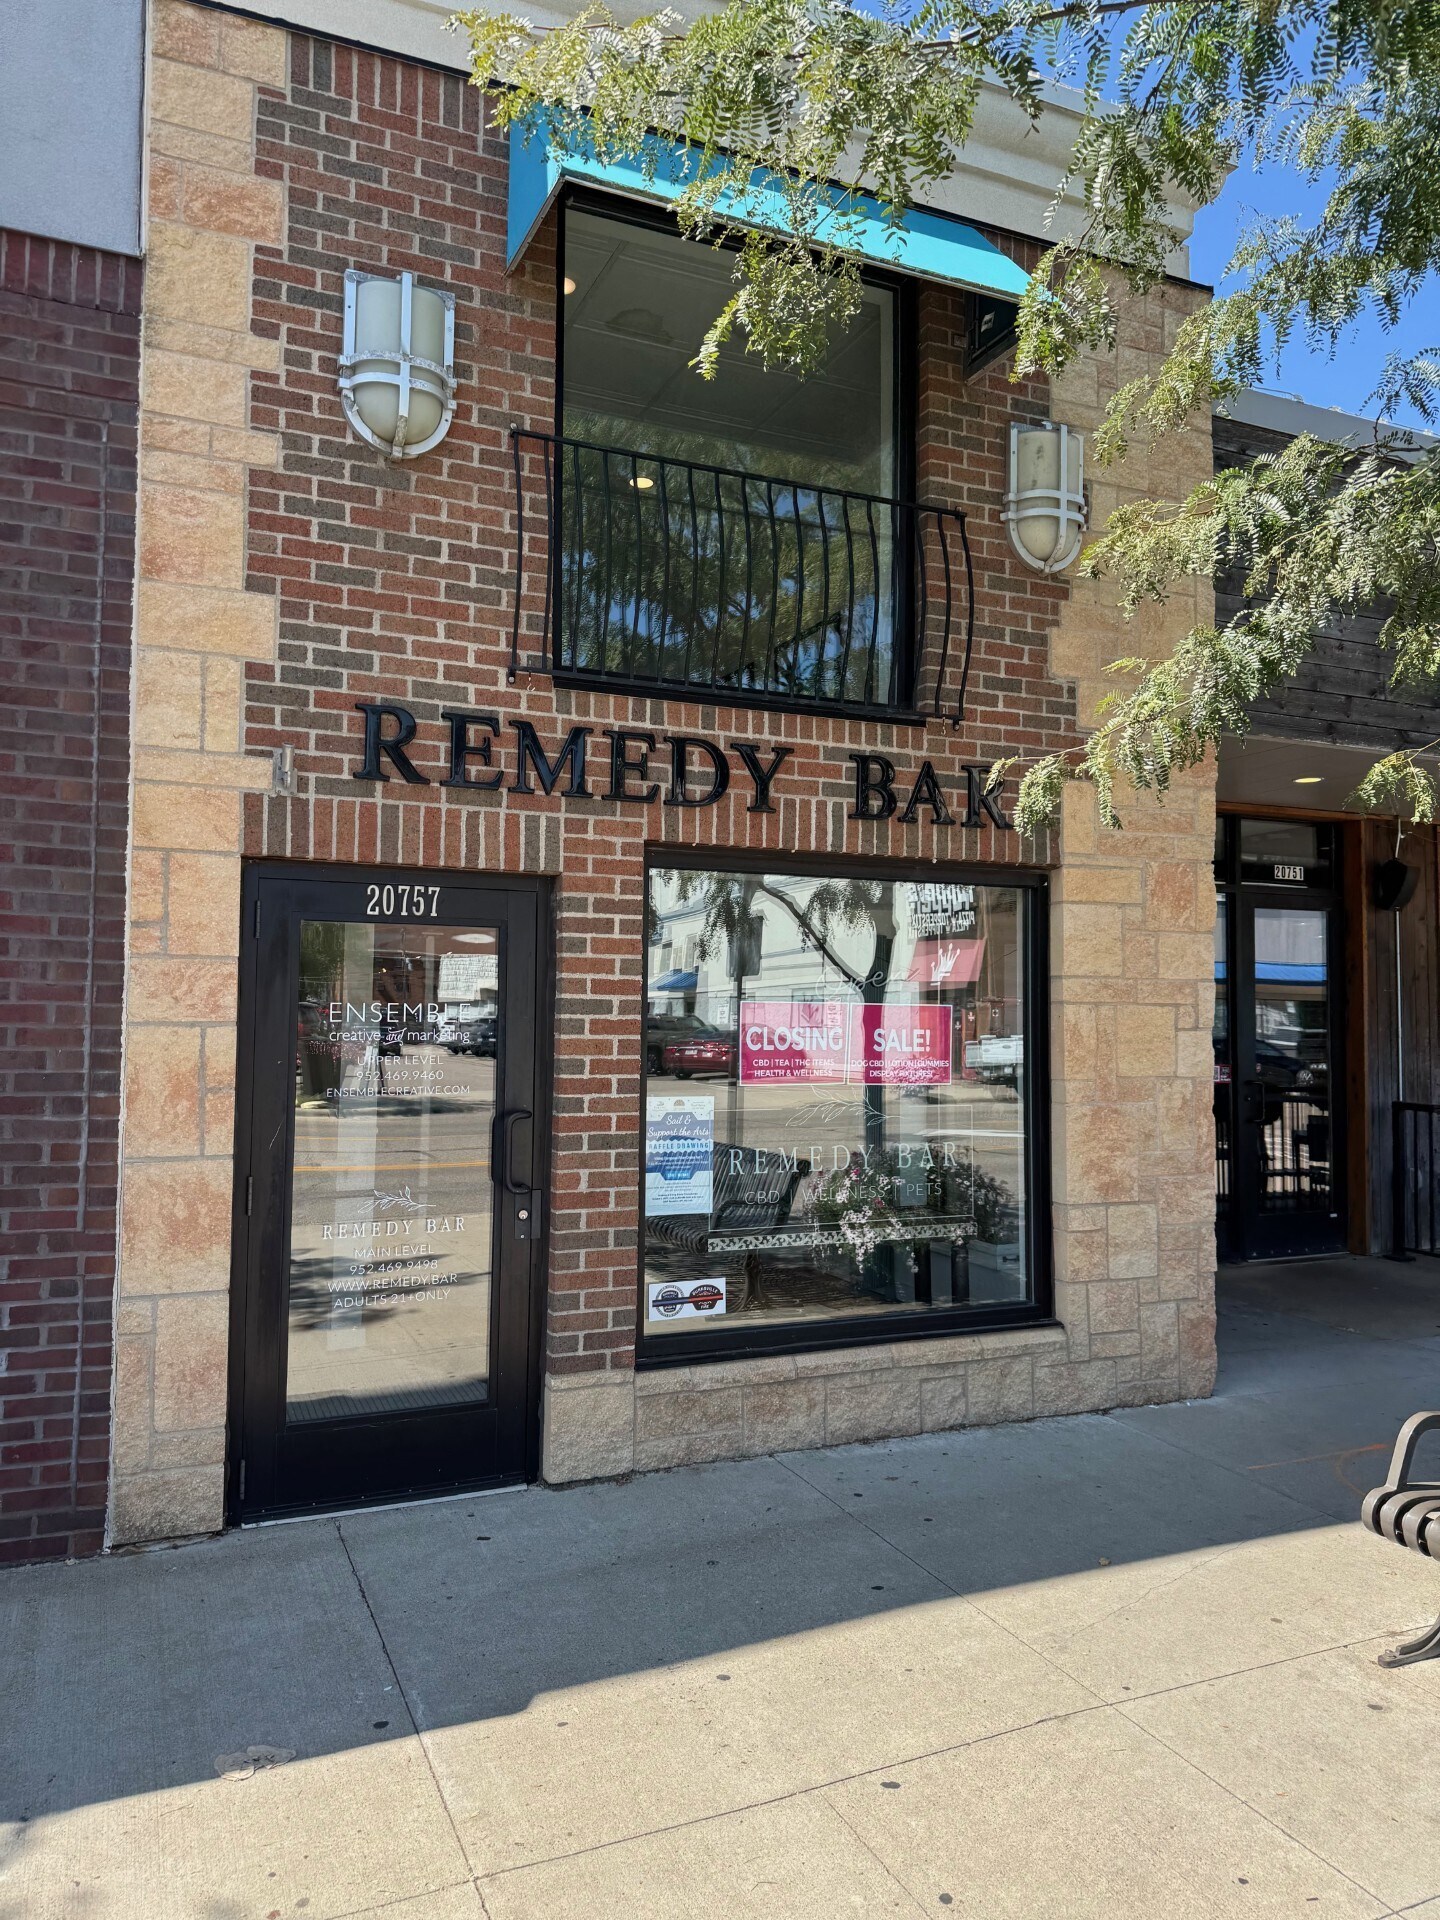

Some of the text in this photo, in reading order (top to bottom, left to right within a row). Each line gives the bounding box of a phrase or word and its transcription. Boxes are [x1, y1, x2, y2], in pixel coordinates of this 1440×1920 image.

[352, 702, 1015, 829] REMEDY BAR
[1275, 866, 1303, 880] 20751
[366, 884, 441, 917] 20757
[328, 1001, 472, 1023] ENSEMBLE
[329, 1027, 471, 1046] creative and marketing
[745, 1026, 843, 1051] CLOSING
[873, 1028, 931, 1053] SALE!
[357, 1054, 444, 1066] UPPER LEVEL
[752, 1059, 835, 1067] CBD TEA THC ITEMS
[868, 1059, 884, 1067] CBD
[356, 1070, 444, 1081] 952.469.9460
[754, 1069, 833, 1077] HEALTH & WELLNESS
[326, 1085, 471, 1098] ENSEMBLECREATIVE.COM
[666, 1114, 682, 1126] Sail
[647, 1126, 709, 1139] Support the Arts
[676, 1142, 709, 1150] DRAWING
[728, 1141, 957, 1176] REMEDY BAR
[745, 1182, 942, 1205] CBD WELLNESS PETS
[322, 1217, 466, 1240] REMEDY BAR
[354, 1244, 435, 1259] MAIN LEVEL
[349, 1259, 438, 1275] 952.469.9498
[327, 1273, 458, 1293] WWW.REMEDY.BAR
[333, 1294, 387, 1309] ADULTS
